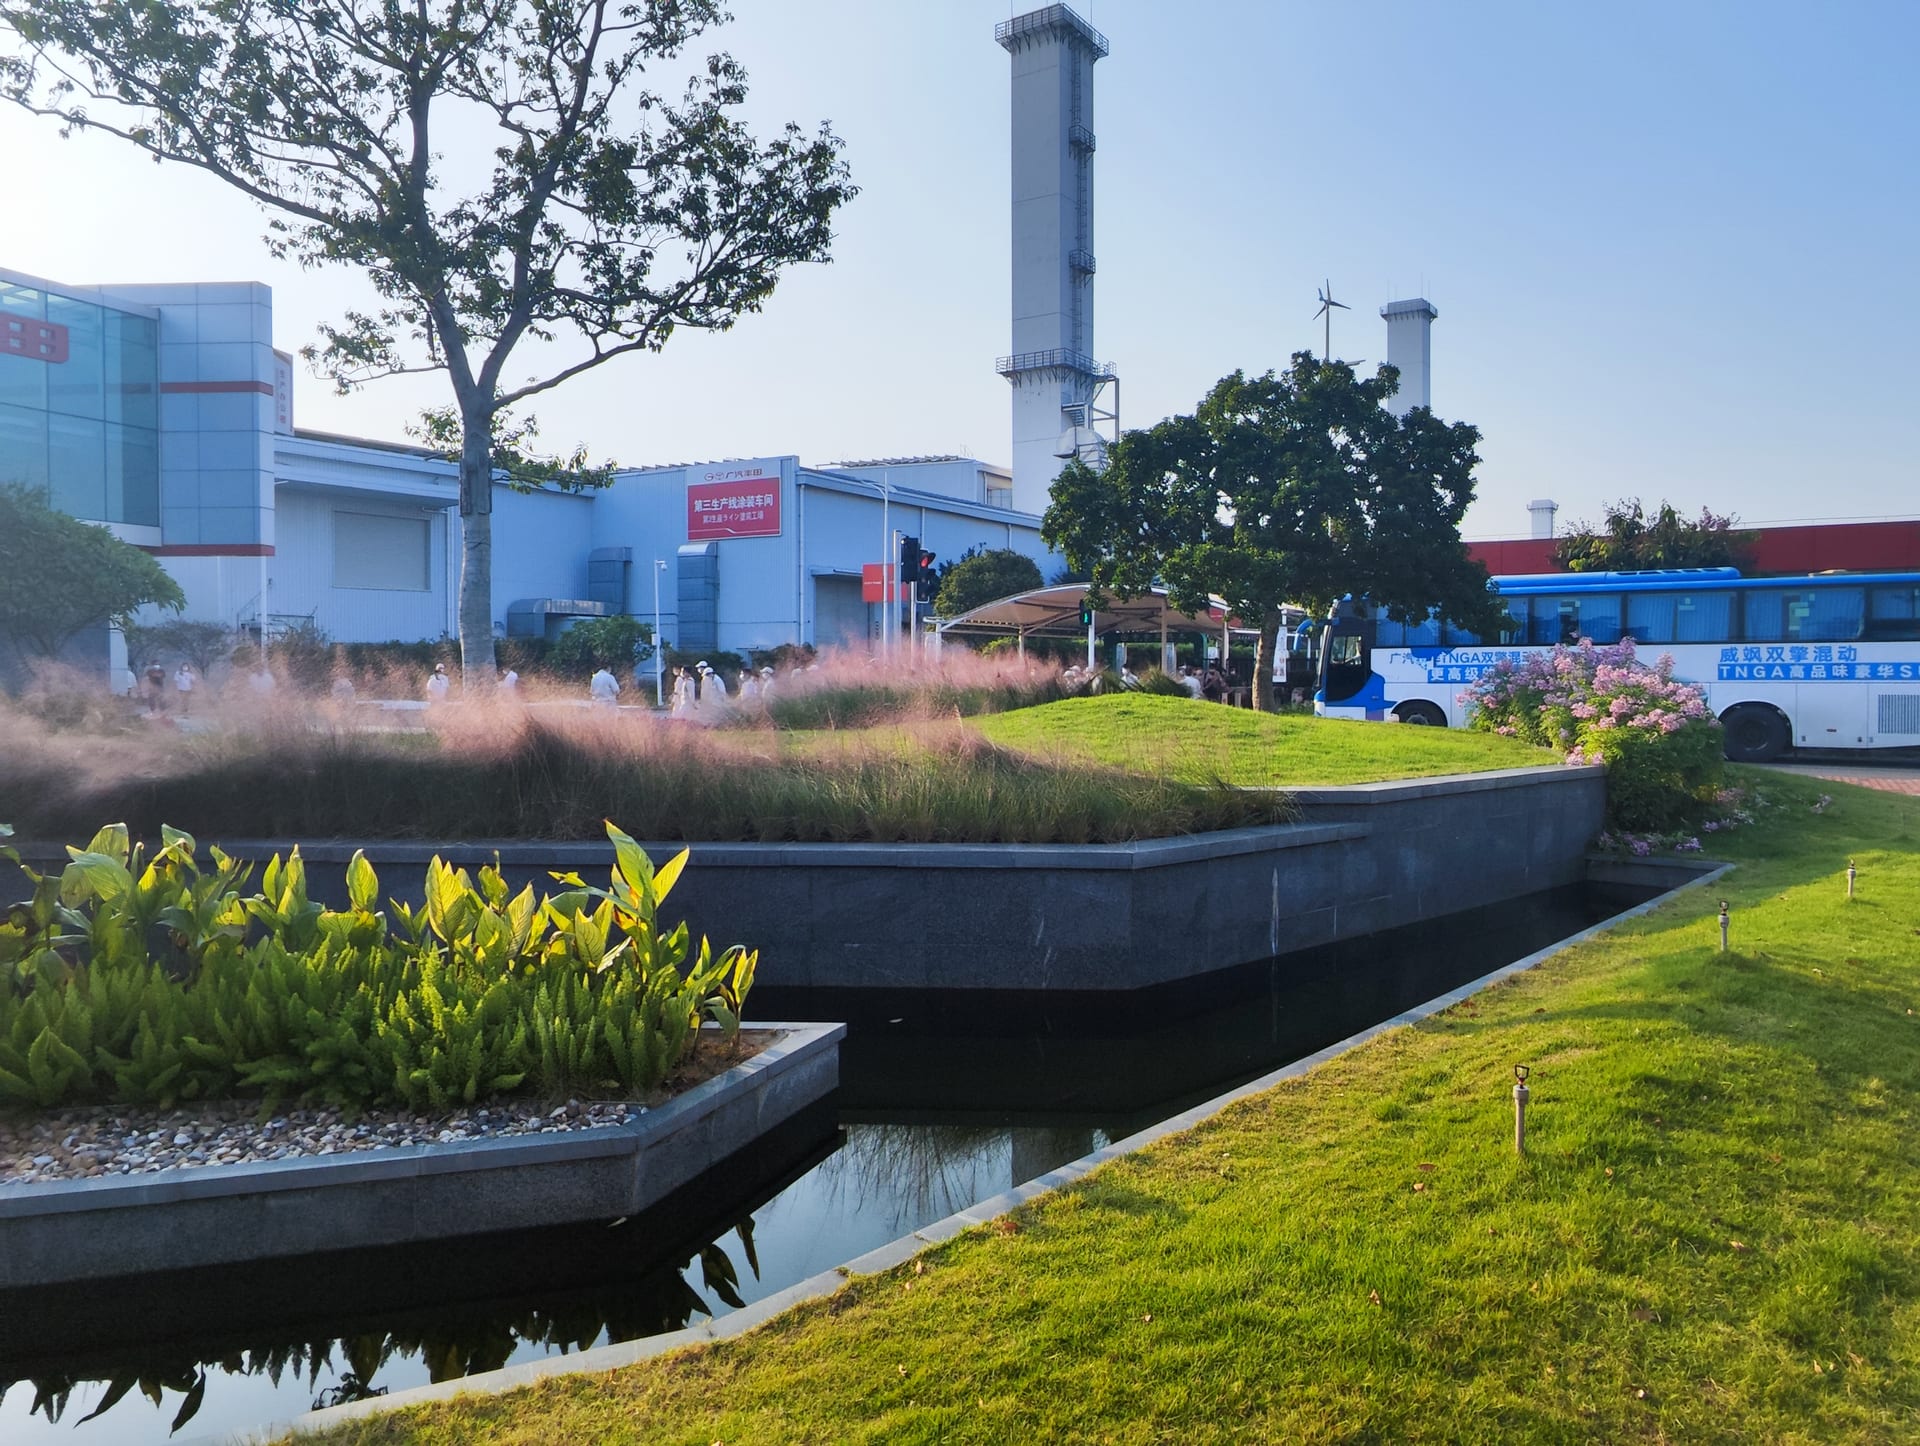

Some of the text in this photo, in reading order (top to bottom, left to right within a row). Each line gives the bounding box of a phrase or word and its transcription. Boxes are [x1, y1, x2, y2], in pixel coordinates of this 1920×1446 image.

[694, 494, 773, 512] 第三生产线涂装车间
[1719, 645, 1857, 662] 威飒双擎混动
[1719, 665, 1920, 678] TNGA高品味豪华S
